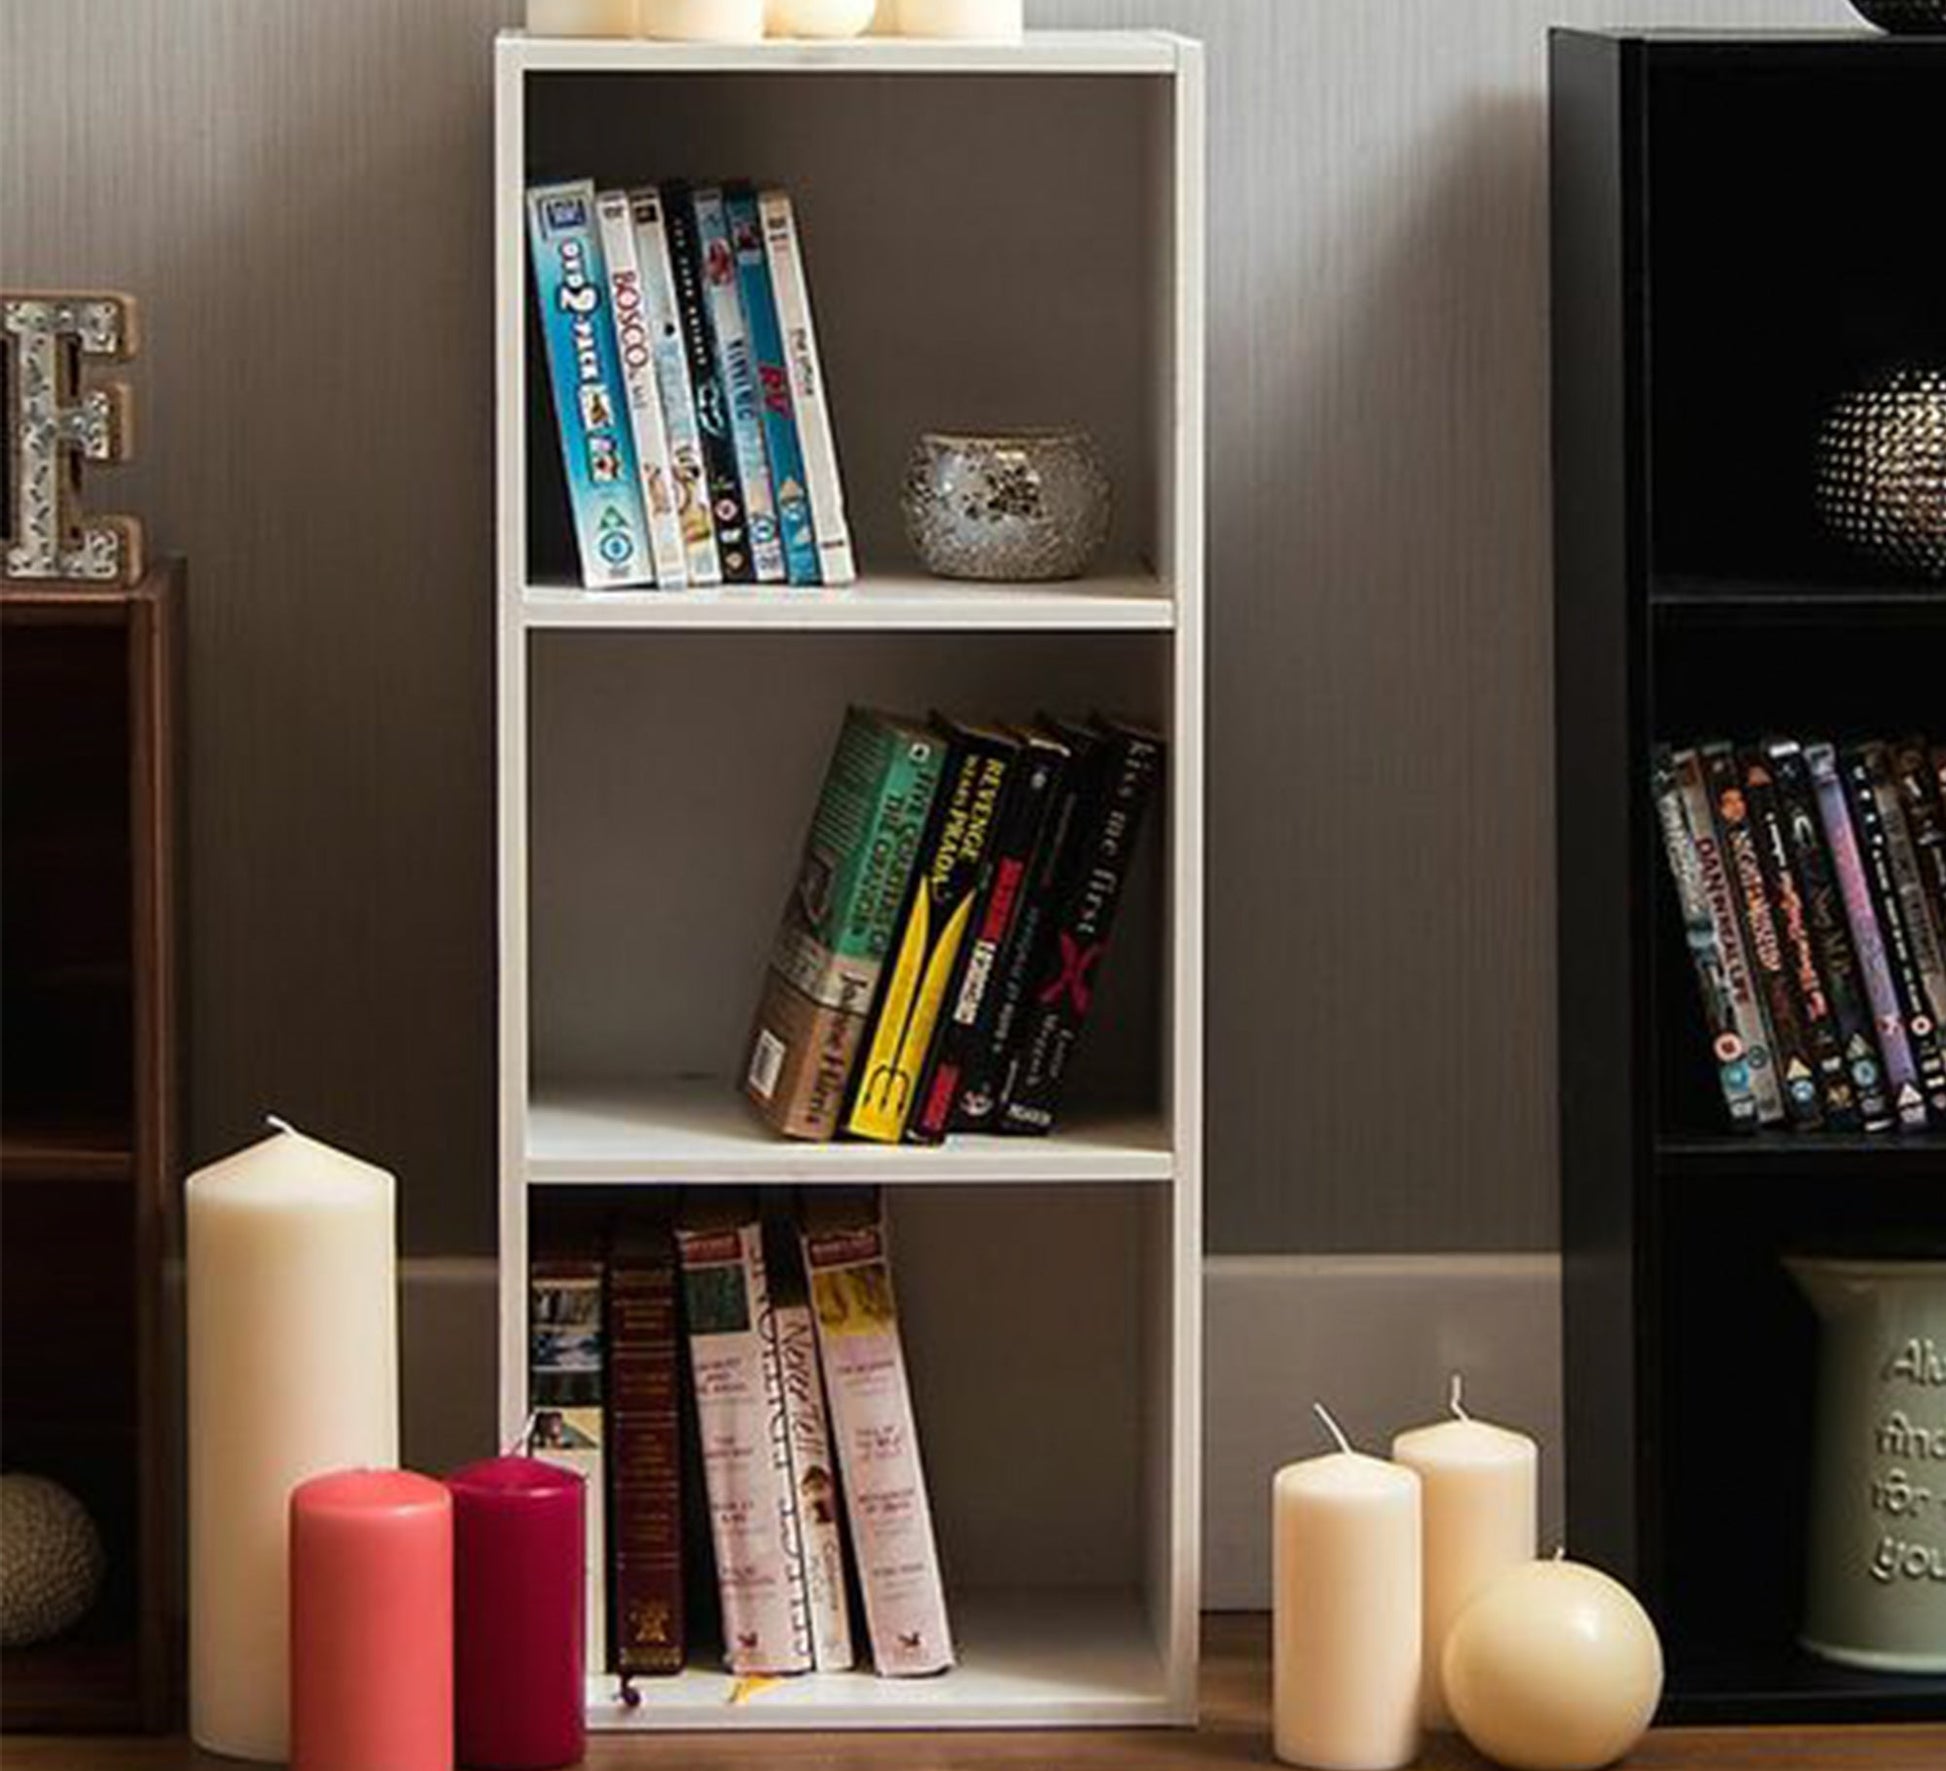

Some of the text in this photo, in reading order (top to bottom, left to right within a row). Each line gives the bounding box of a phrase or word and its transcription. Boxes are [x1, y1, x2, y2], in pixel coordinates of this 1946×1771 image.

[561, 240, 584, 288] DVD
[931, 808, 969, 884] PRADA
[958, 757, 1005, 863] REVENGE
[1076, 739, 1156, 935] kiss me first
[1695, 838, 1725, 893] DAN
[783, 1320, 813, 1401] Never
